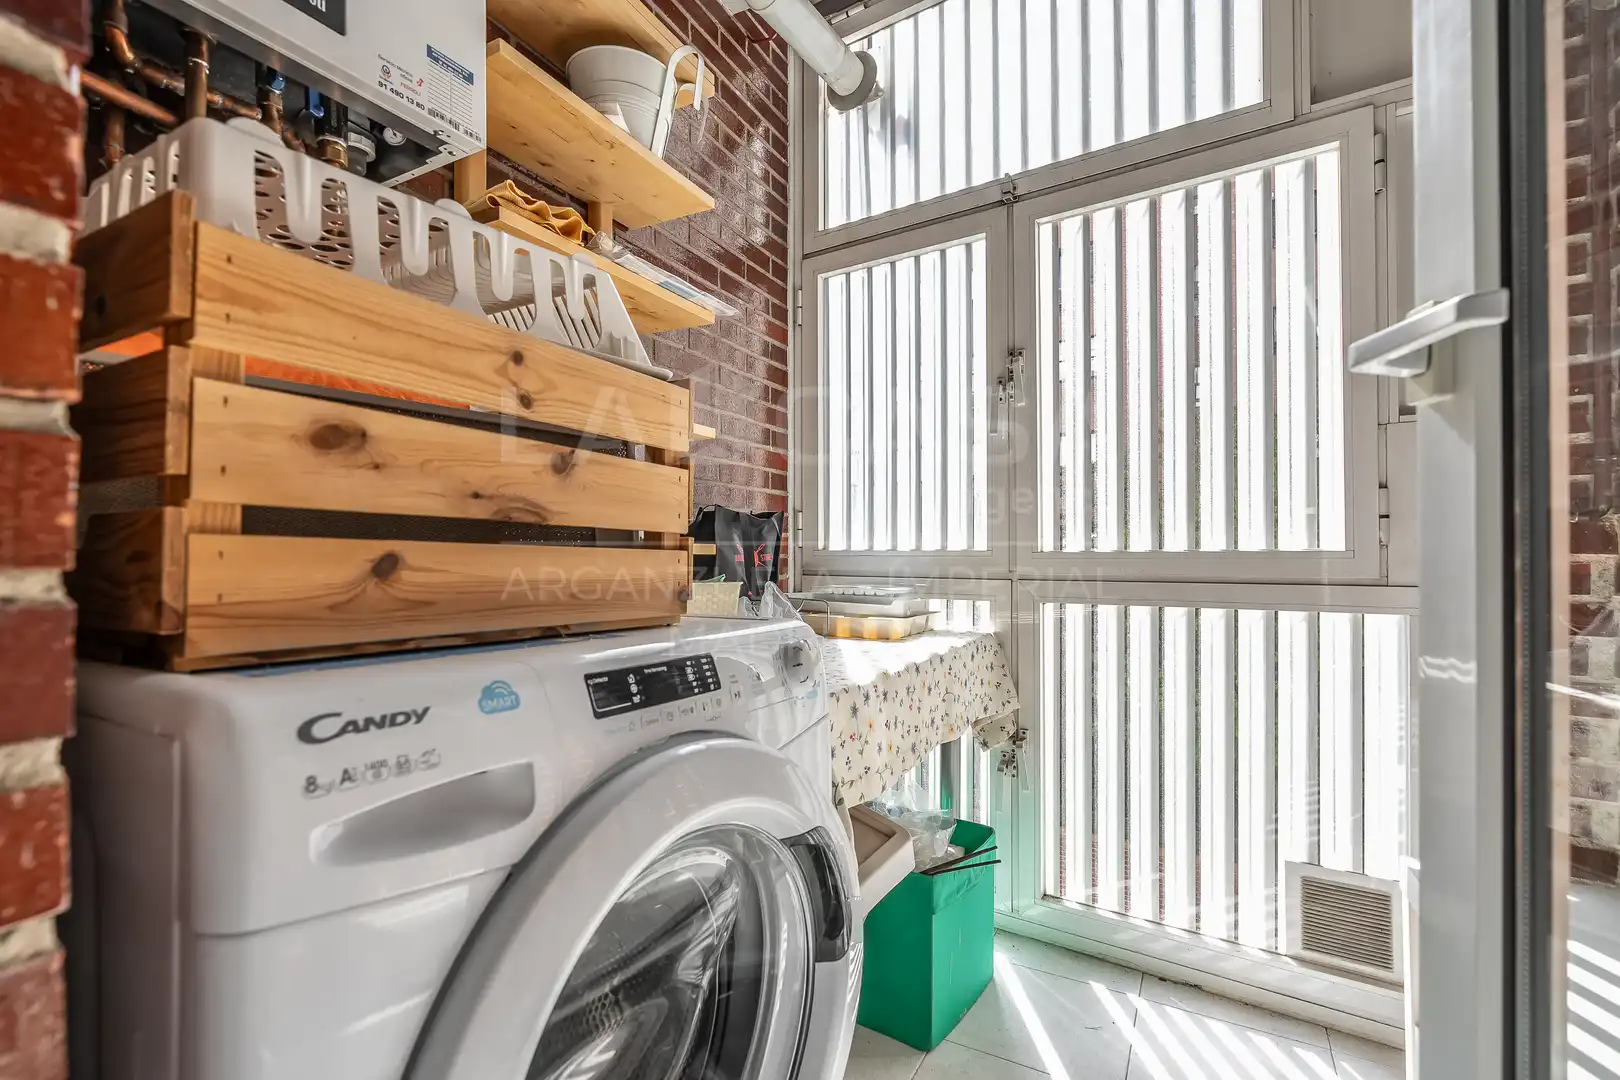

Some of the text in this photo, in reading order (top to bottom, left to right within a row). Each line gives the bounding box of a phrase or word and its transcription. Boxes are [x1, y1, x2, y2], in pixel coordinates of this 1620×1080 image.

[378, 80, 388, 91] 91
[390, 88, 404, 99] 490
[406, 95, 415, 105] 13
[482, 694, 517, 710] SMART
